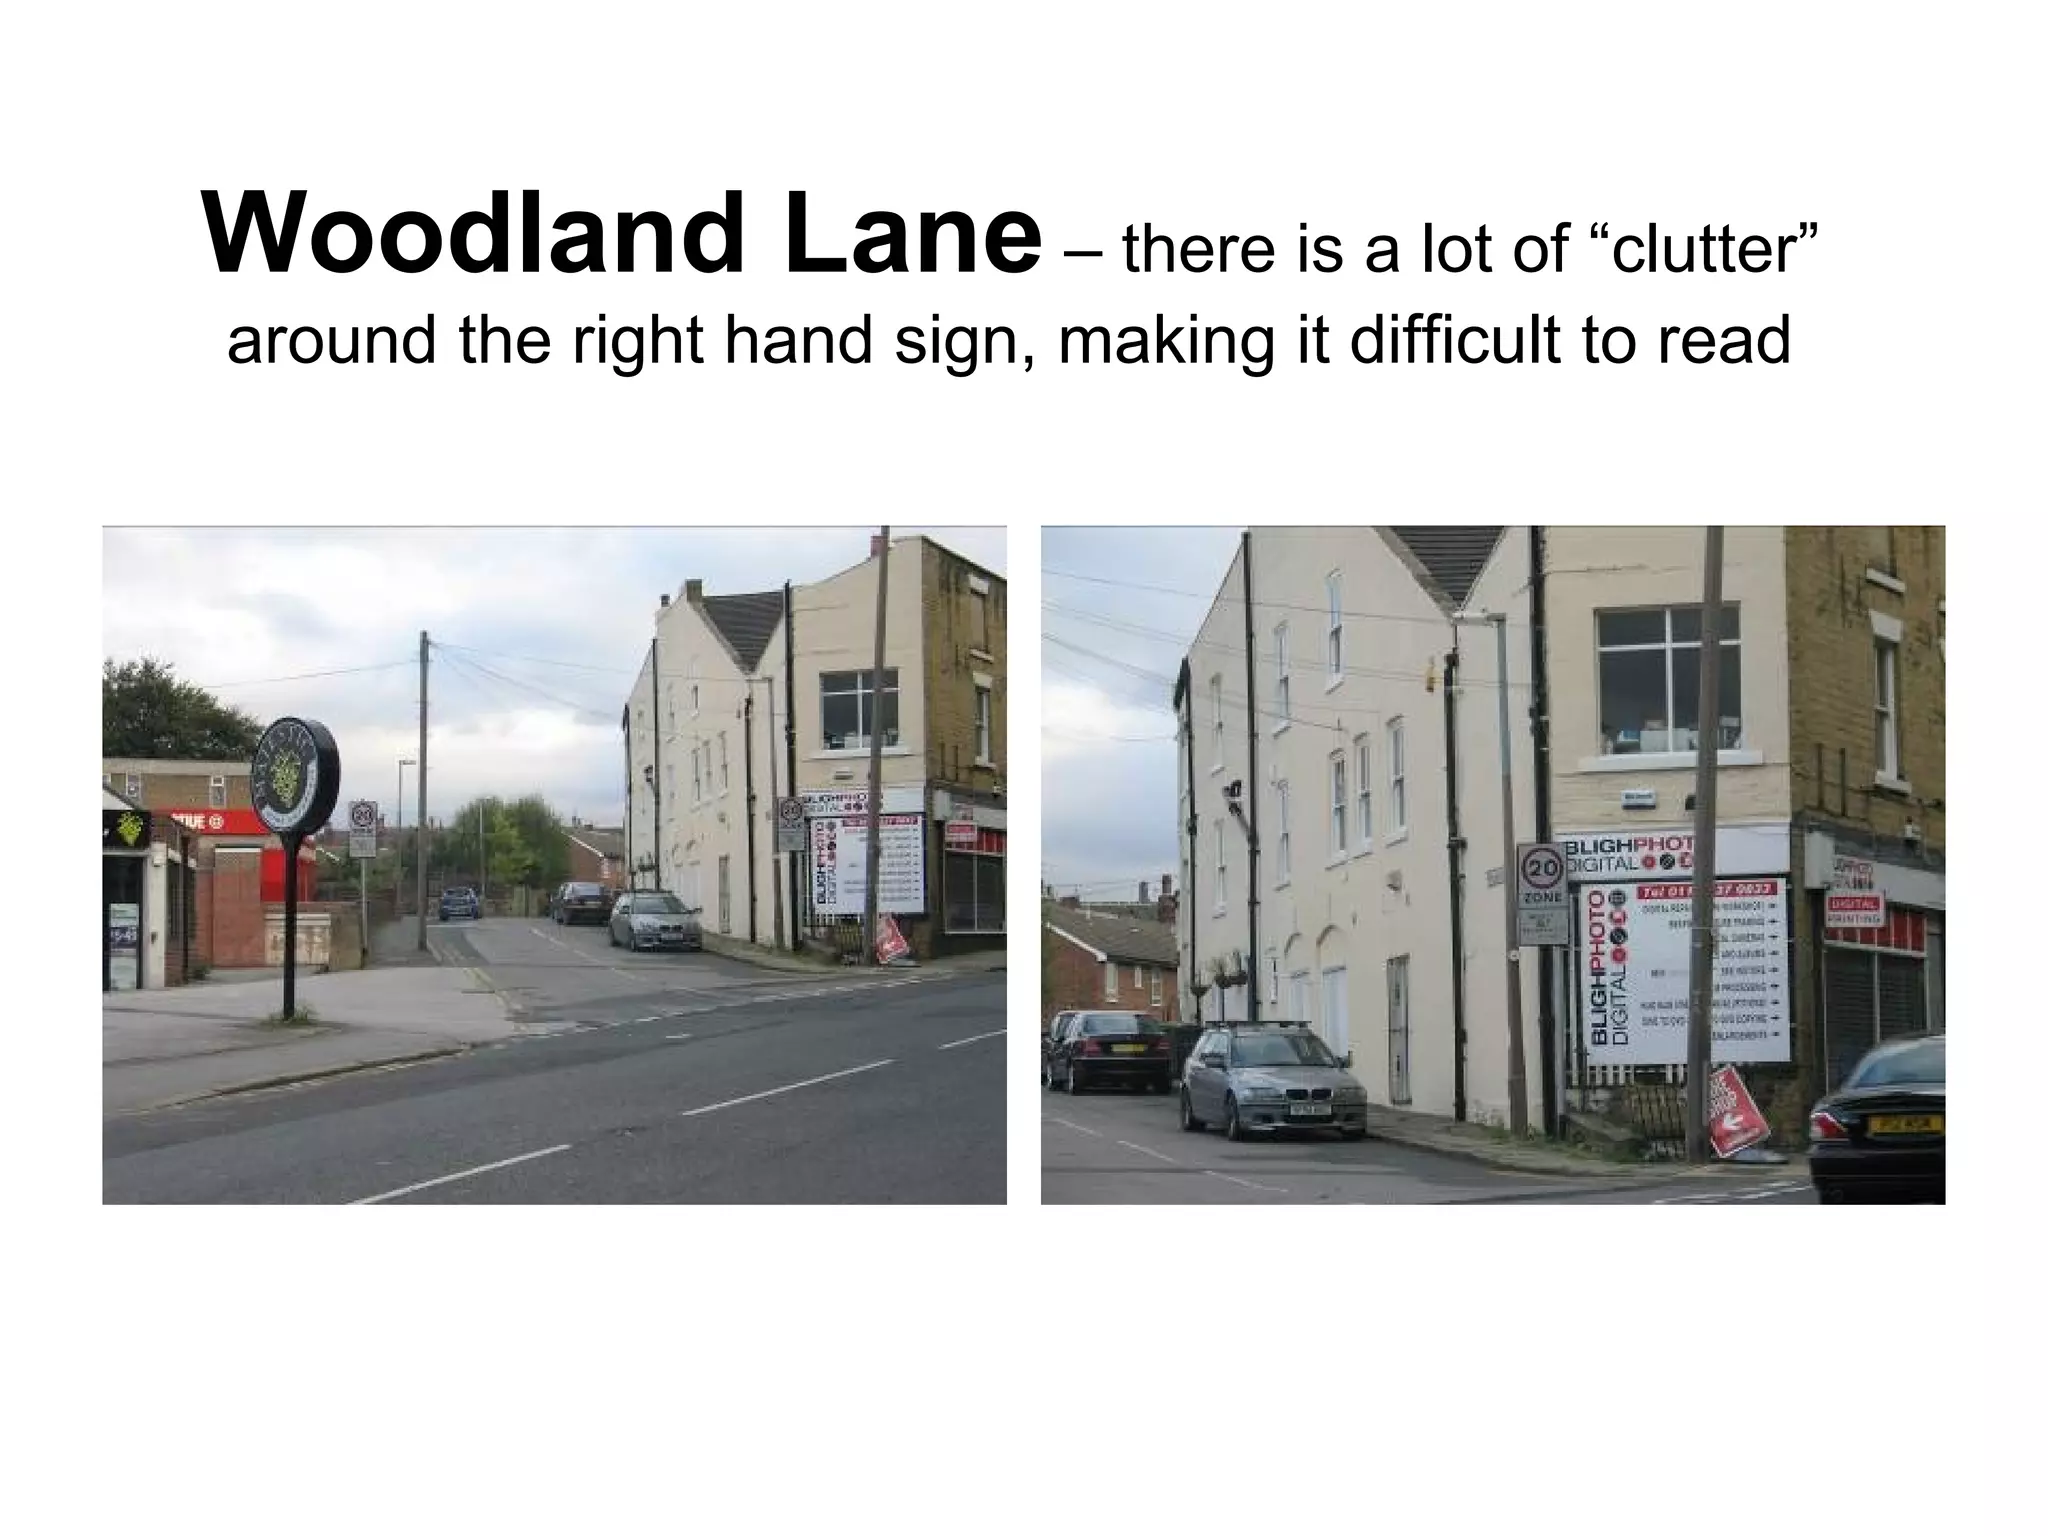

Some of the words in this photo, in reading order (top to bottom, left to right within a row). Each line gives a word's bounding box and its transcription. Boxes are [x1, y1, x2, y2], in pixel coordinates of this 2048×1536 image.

[1566, 835, 1695, 855] BLIGHPHOT
[1529, 859, 1558, 876] 20
[1567, 855, 1639, 872] DIGITAL
[1524, 892, 1562, 904] ZONE
[1588, 890, 1608, 1045] BLIGHPHOTO
[1610, 963, 1629, 1045] DIGITAL
